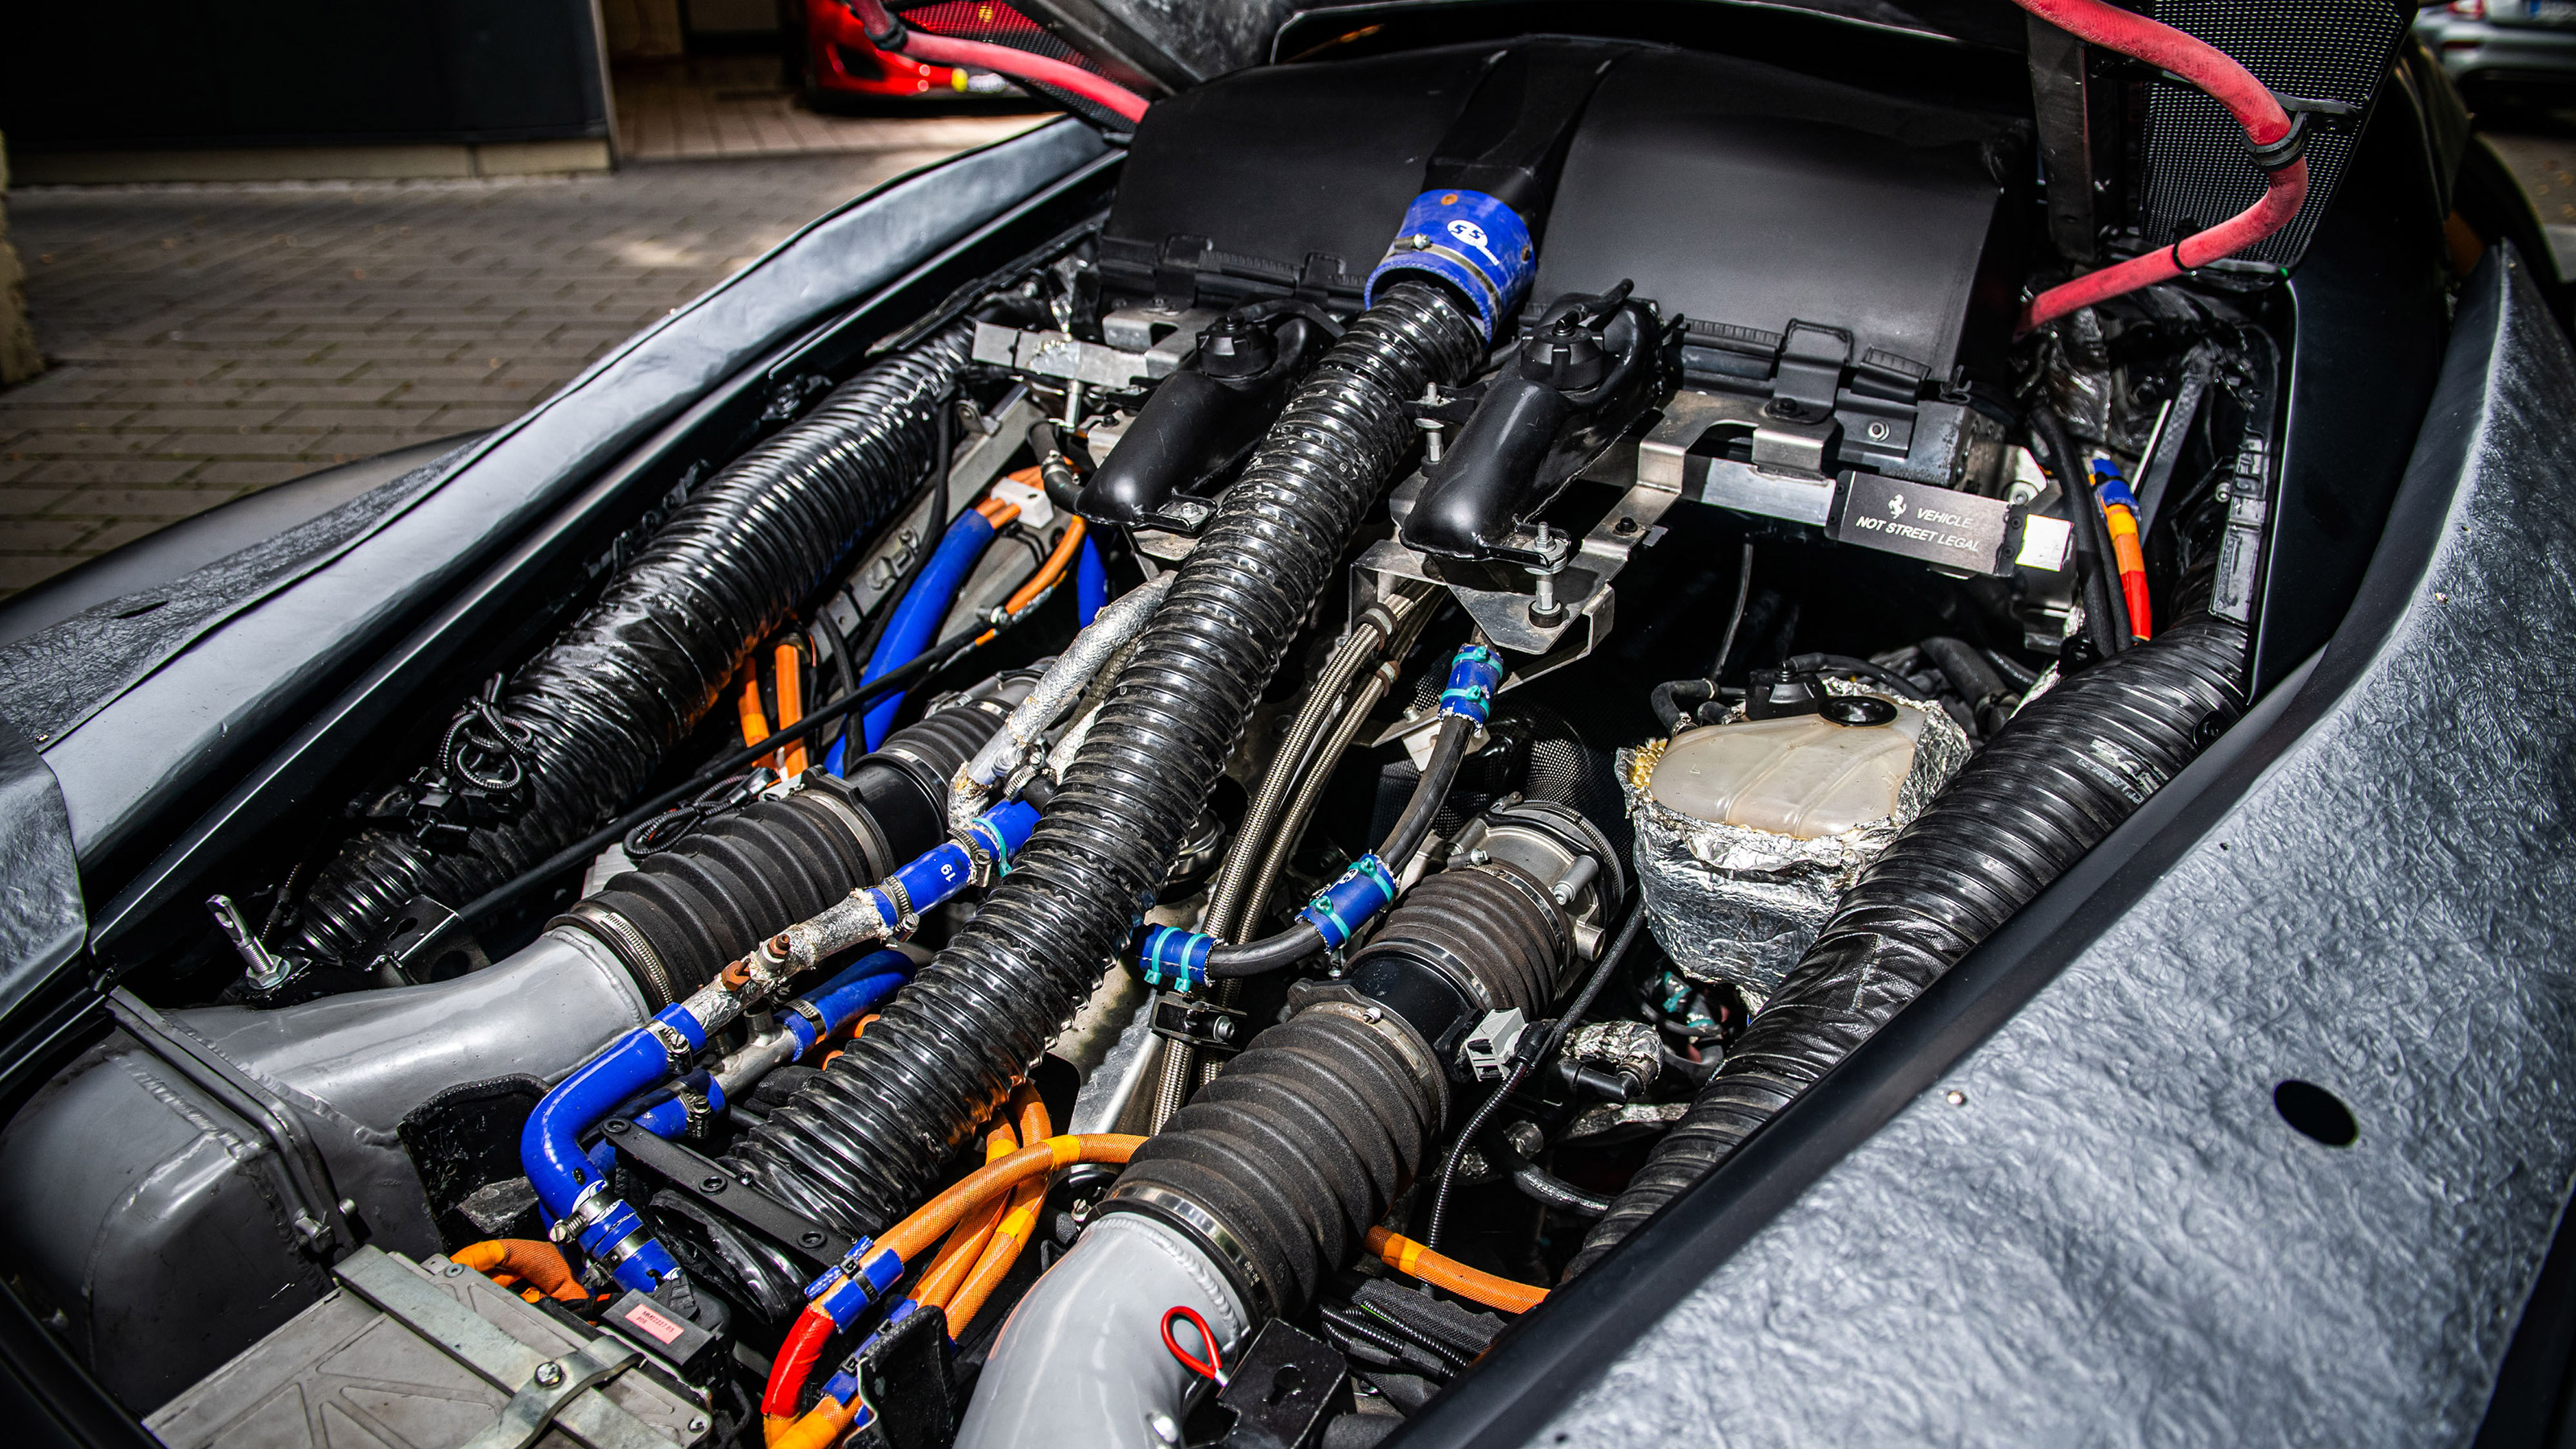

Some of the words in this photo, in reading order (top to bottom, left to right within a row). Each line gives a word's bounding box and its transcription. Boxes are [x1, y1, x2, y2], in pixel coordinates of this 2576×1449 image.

[1917, 507, 1974, 529] VEHICLE
[1856, 515, 1886, 531] NOT
[1885, 522, 1938, 543] STREET
[1937, 534, 1980, 552] LEGAL
[940, 863, 957, 882] 19
